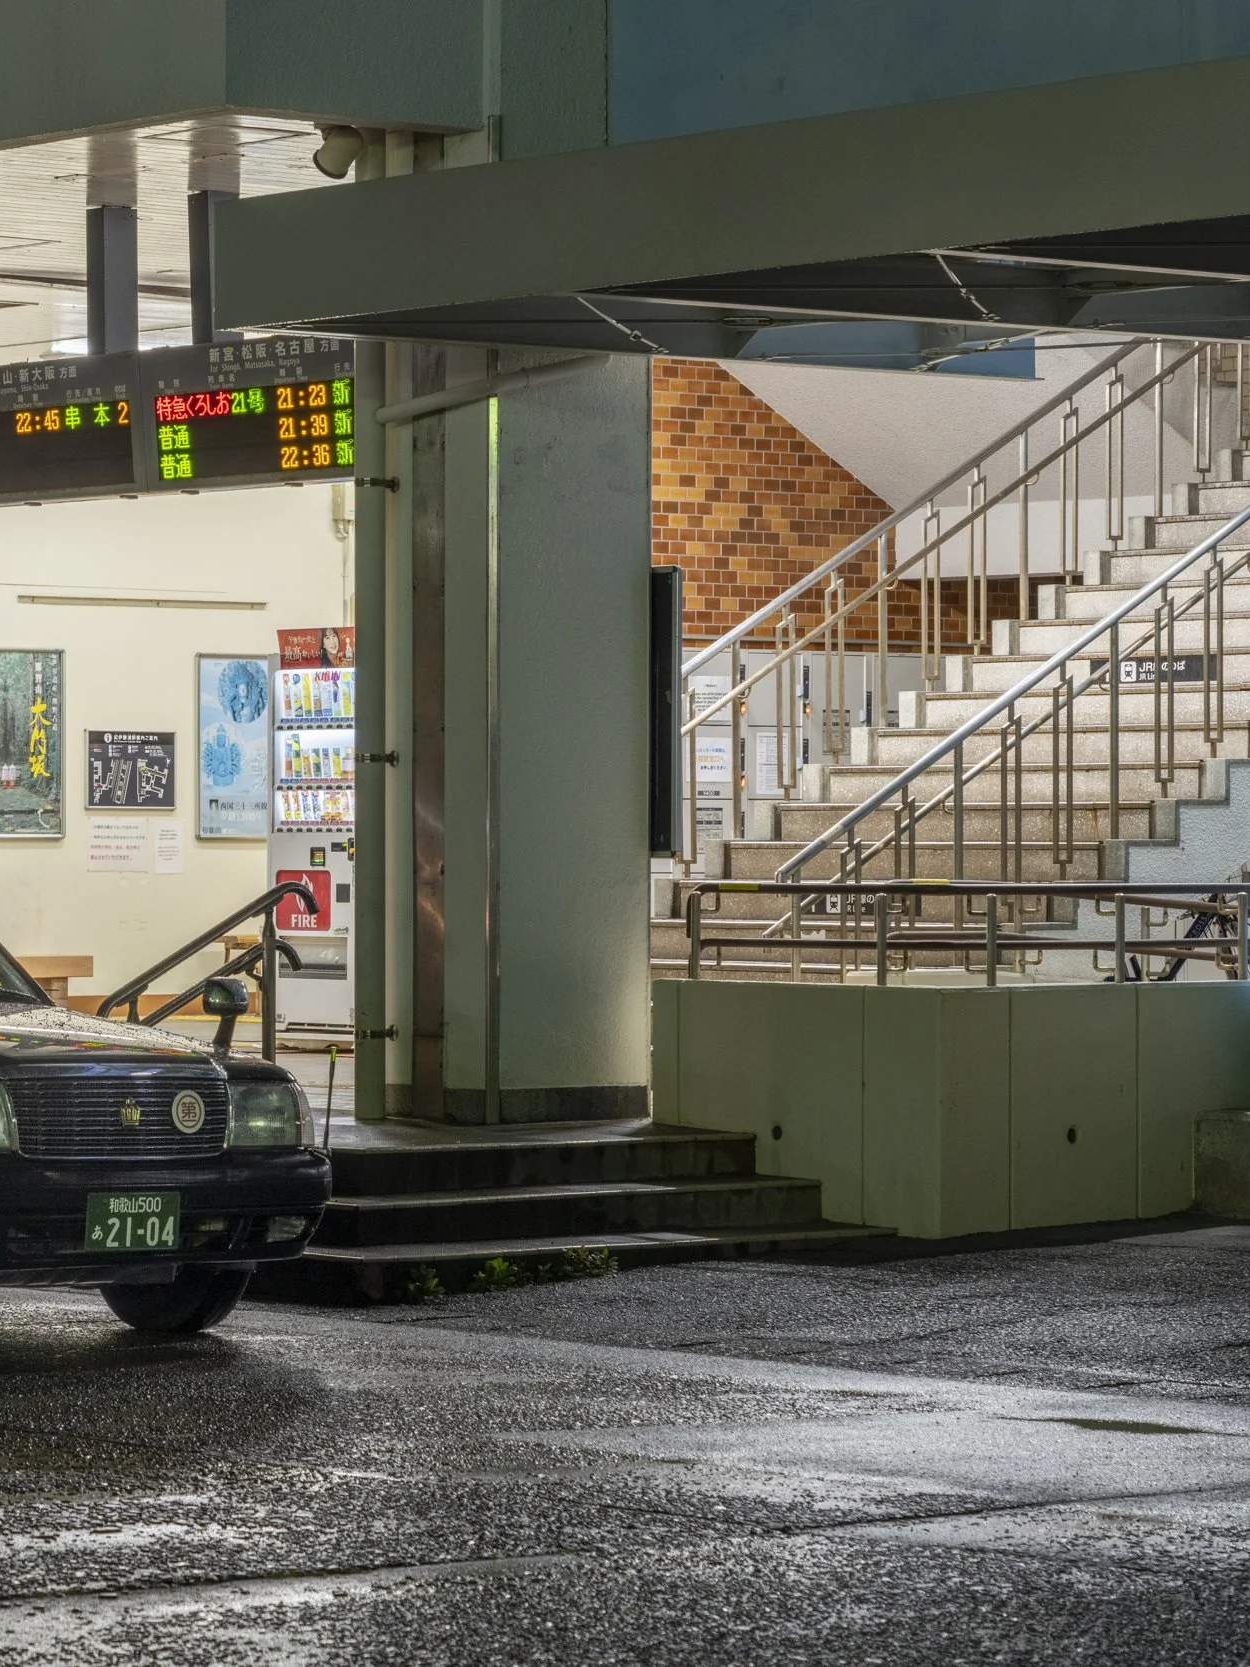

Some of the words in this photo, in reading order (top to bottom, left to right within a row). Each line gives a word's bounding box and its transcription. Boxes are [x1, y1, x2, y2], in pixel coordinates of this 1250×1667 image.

[278, 357, 300, 367] Nagoya
[277, 384, 326, 410] 21:23
[16, 410, 60, 433] 22:45
[117, 402, 129, 424] 2
[159, 425, 191, 450] 普通
[279, 414, 329, 440] 21:39
[160, 454, 193, 479] 普通
[281, 444, 331, 469] 22:36
[315, 670, 342, 682] KIRIN
[291, 914, 318, 928] FIRE
[91, 1225, 104, 1241] あ
[106, 1216, 175, 1248] 21-04
